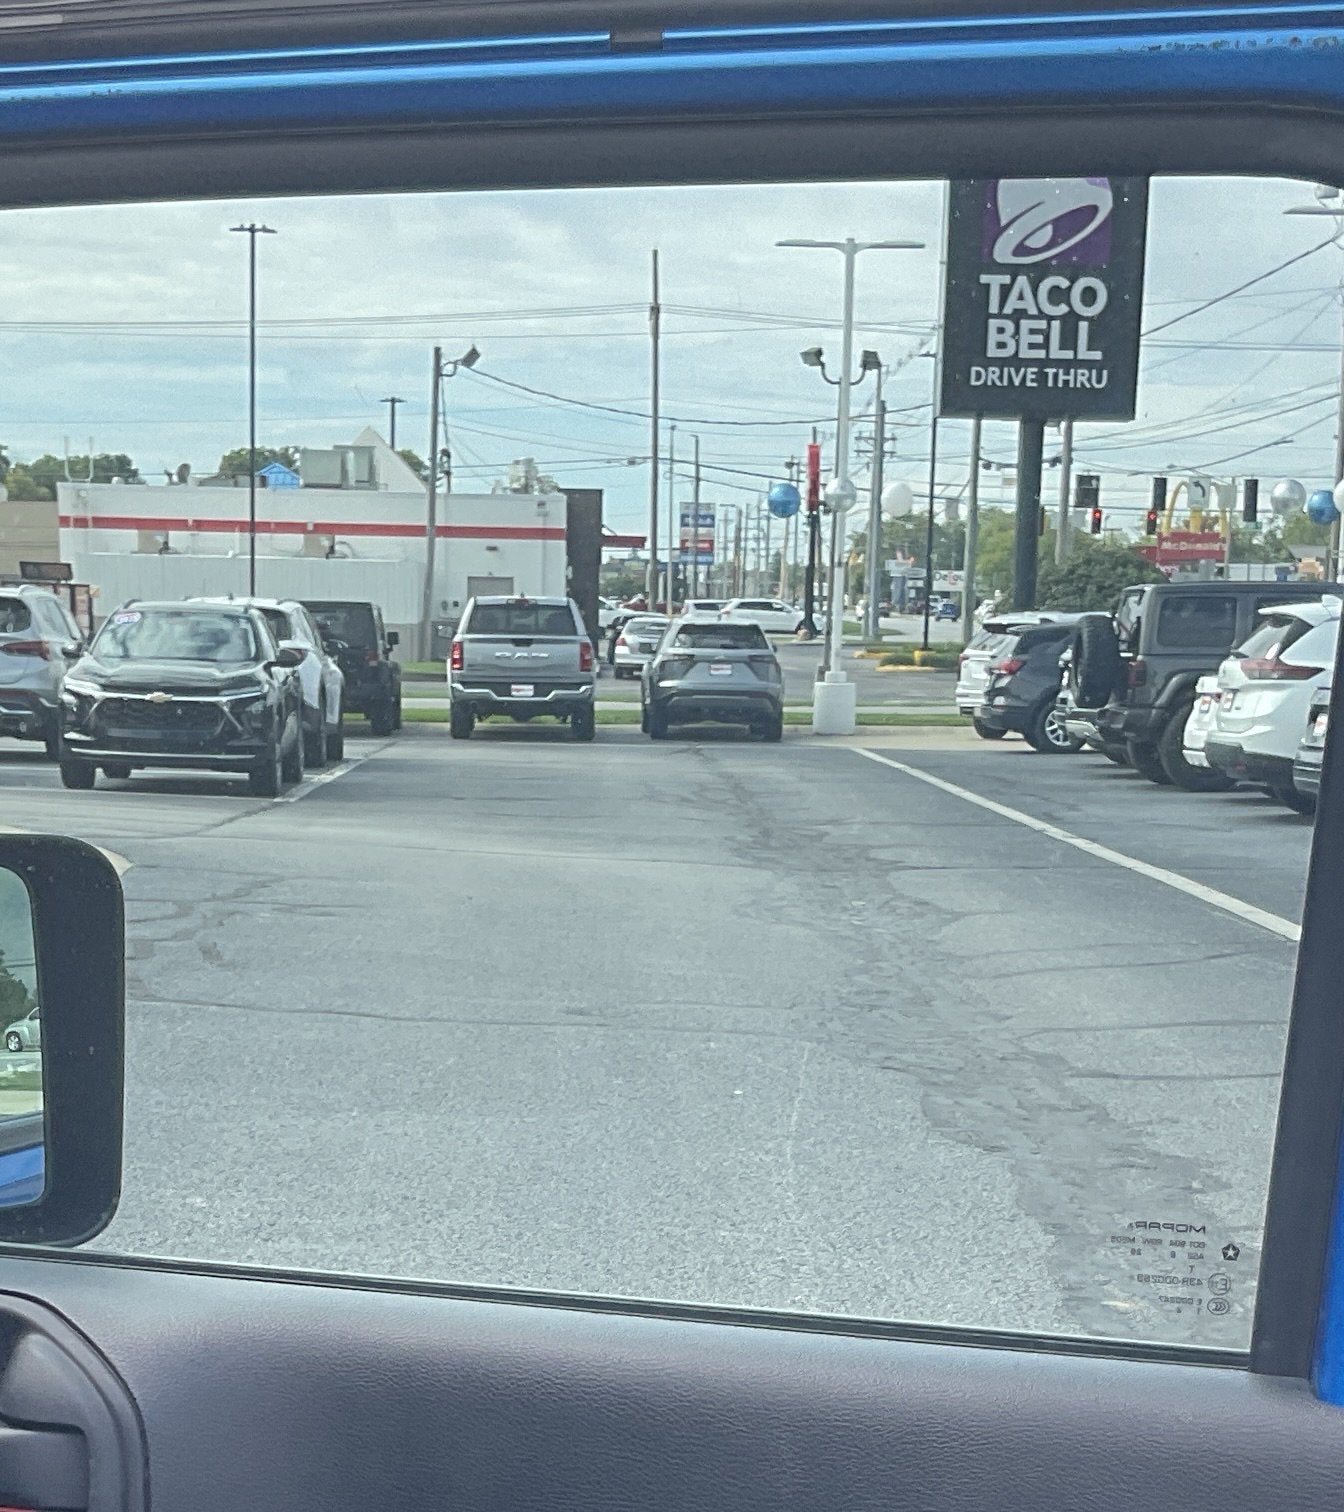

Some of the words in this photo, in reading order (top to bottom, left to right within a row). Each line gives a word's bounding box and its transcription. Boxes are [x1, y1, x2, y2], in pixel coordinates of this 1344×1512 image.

[979, 274, 1108, 317] TACO
[985, 319, 1103, 360] BELL
[969, 366, 1038, 388] DRIVE
[1043, 367, 1108, 389] THRU
